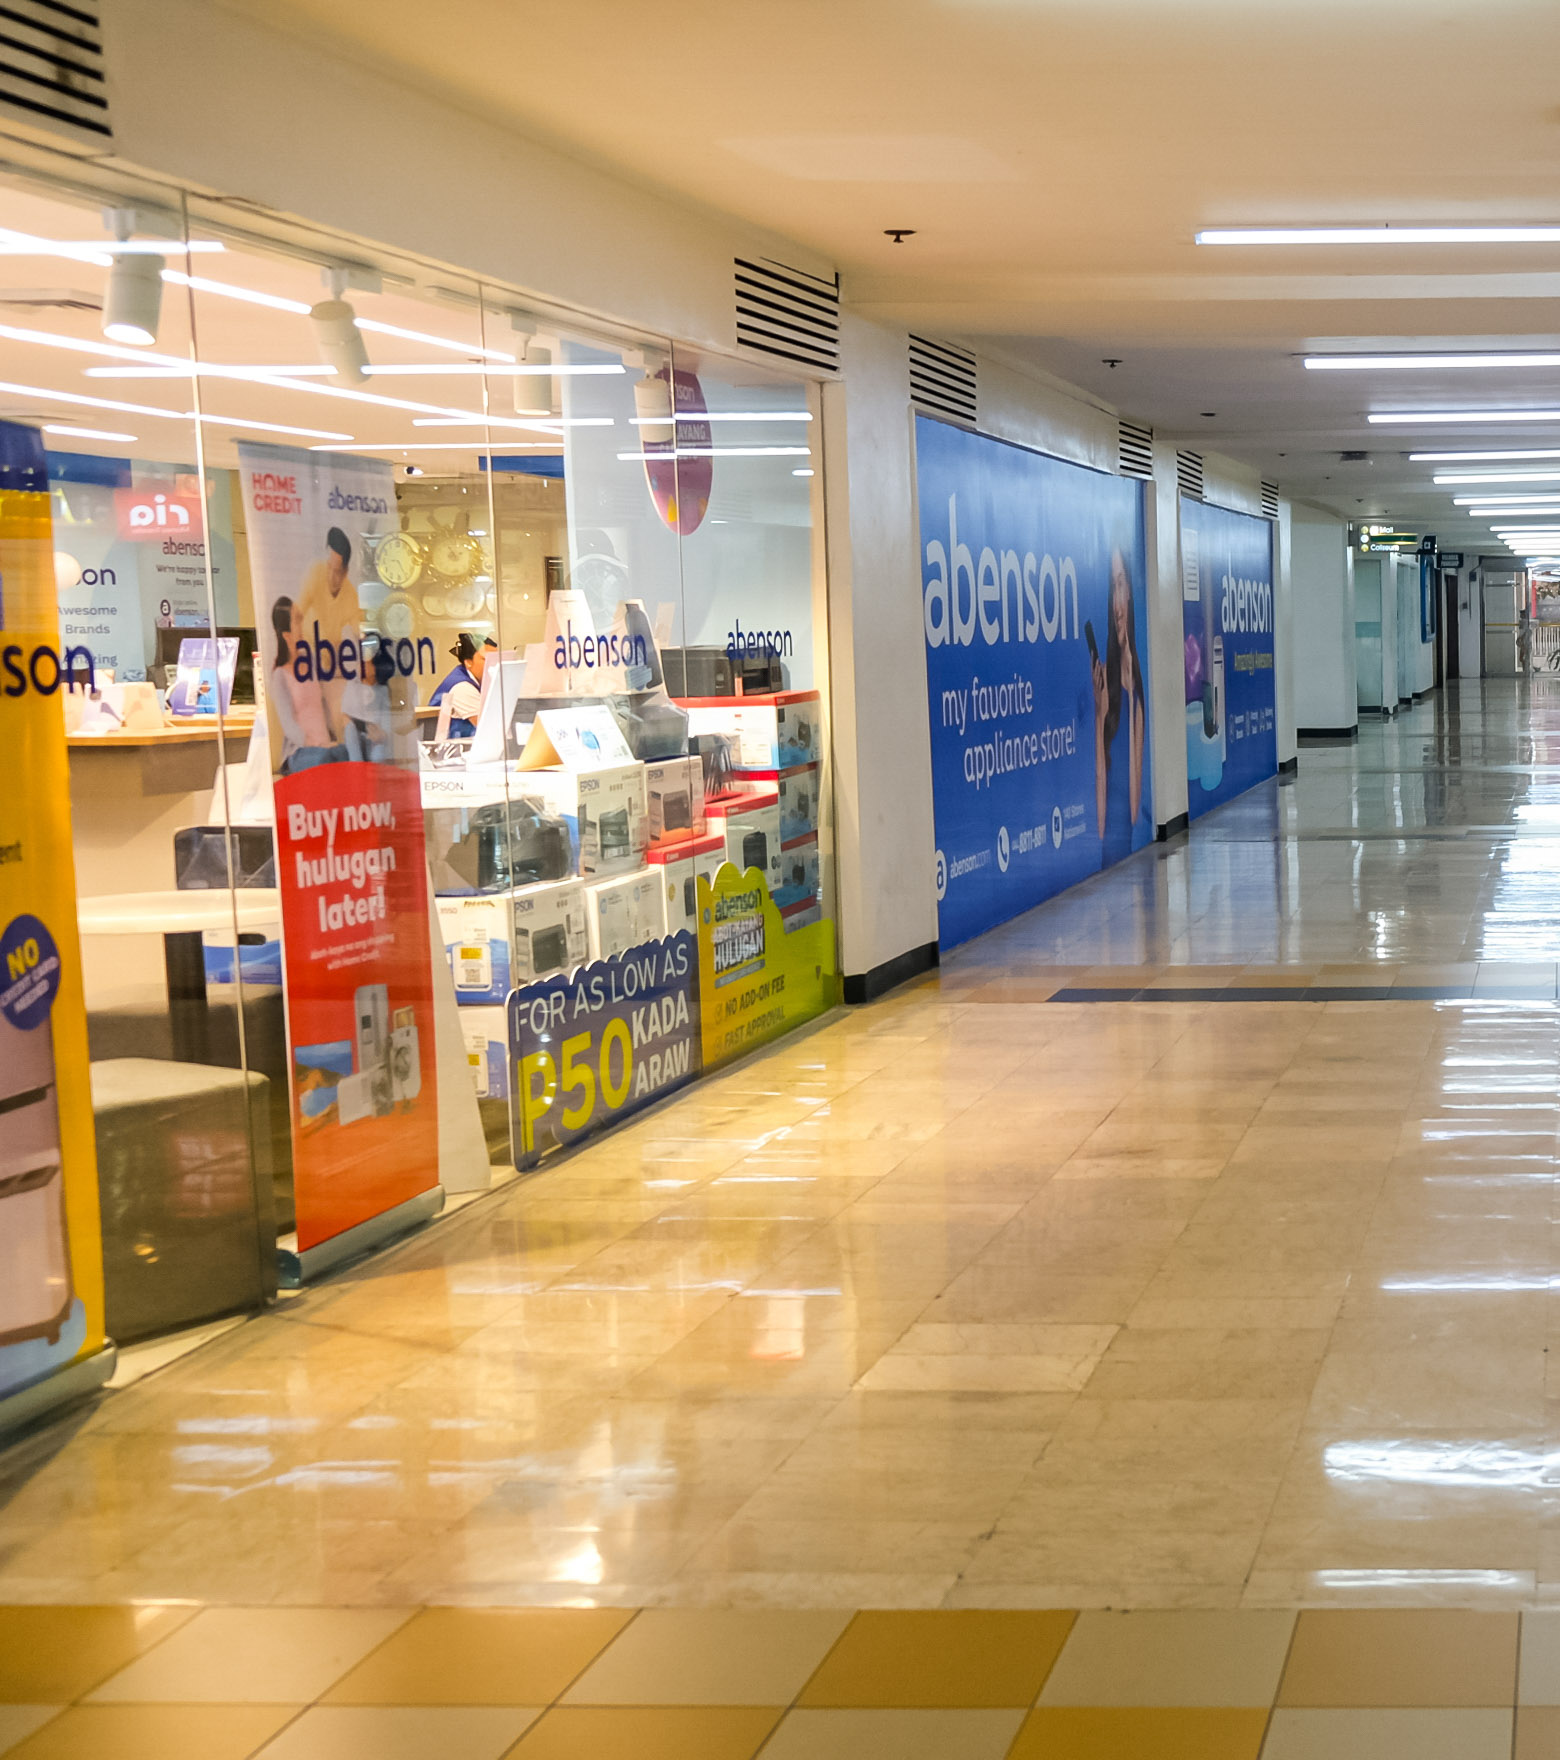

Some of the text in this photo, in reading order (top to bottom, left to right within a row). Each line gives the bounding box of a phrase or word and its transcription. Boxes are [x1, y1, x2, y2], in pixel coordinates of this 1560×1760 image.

[252, 472, 297, 494] HOME
[328, 485, 388, 514] abenson
[253, 494, 303, 516] CREDIT
[162, 537, 207, 557] abenso
[76, 568, 117, 586] on
[924, 492, 1079, 649] abenson
[1221, 552, 1273, 634] abenson
[65, 624, 111, 635] Brands
[554, 619, 648, 669] abenson
[726, 619, 793, 661] abenson
[0, 645, 96, 697] son
[292, 620, 436, 684] abenson
[942, 673, 1034, 736] my favorite
[964, 717, 1076, 791] appliance store!
[424, 781, 464, 792] EPSON
[580, 778, 600, 793] EPSON
[287, 801, 397, 847] Buy now,
[295, 846, 397, 889] hulugan
[318, 885, 386, 933] later!
[515, 898, 534, 913] PSON
[715, 888, 762, 923] abenson
[7, 938, 40, 981] NO
[714, 928, 766, 974] HULUGAN
[515, 990, 566, 1042] FOR
[573, 976, 605, 1020] AS
[611, 954, 657, 1004] LOW
[662, 943, 688, 983] AS
[725, 998, 737, 1017] NO
[771, 975, 785, 995] FEE
[632, 990, 690, 1050] KADA
[724, 1005, 786, 1048] FAST APPROVAL
[635, 1037, 691, 1098] ARAW
